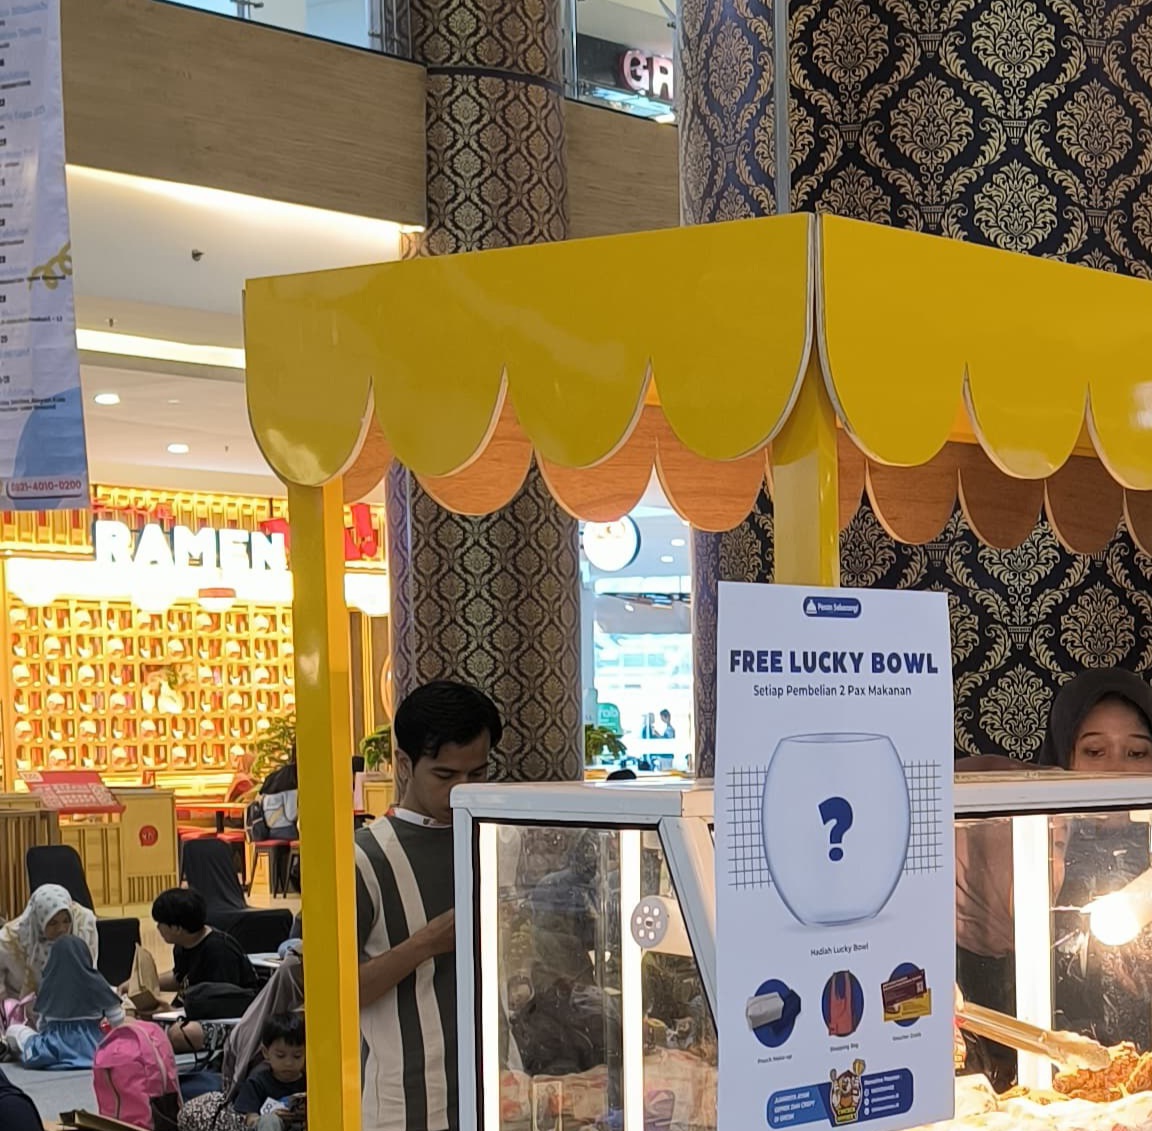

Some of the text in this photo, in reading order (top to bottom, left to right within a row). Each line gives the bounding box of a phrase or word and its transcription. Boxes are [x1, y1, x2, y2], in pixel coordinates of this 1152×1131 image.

[95, 520, 286, 571] RAMEN
[730, 650, 939, 674] FREE LUCKY BOWL
[753, 684, 912, 697] Setiap Pembelian 2 Pax Makanan
[810, 941, 869, 957] Hadiah Lucky Bowl
